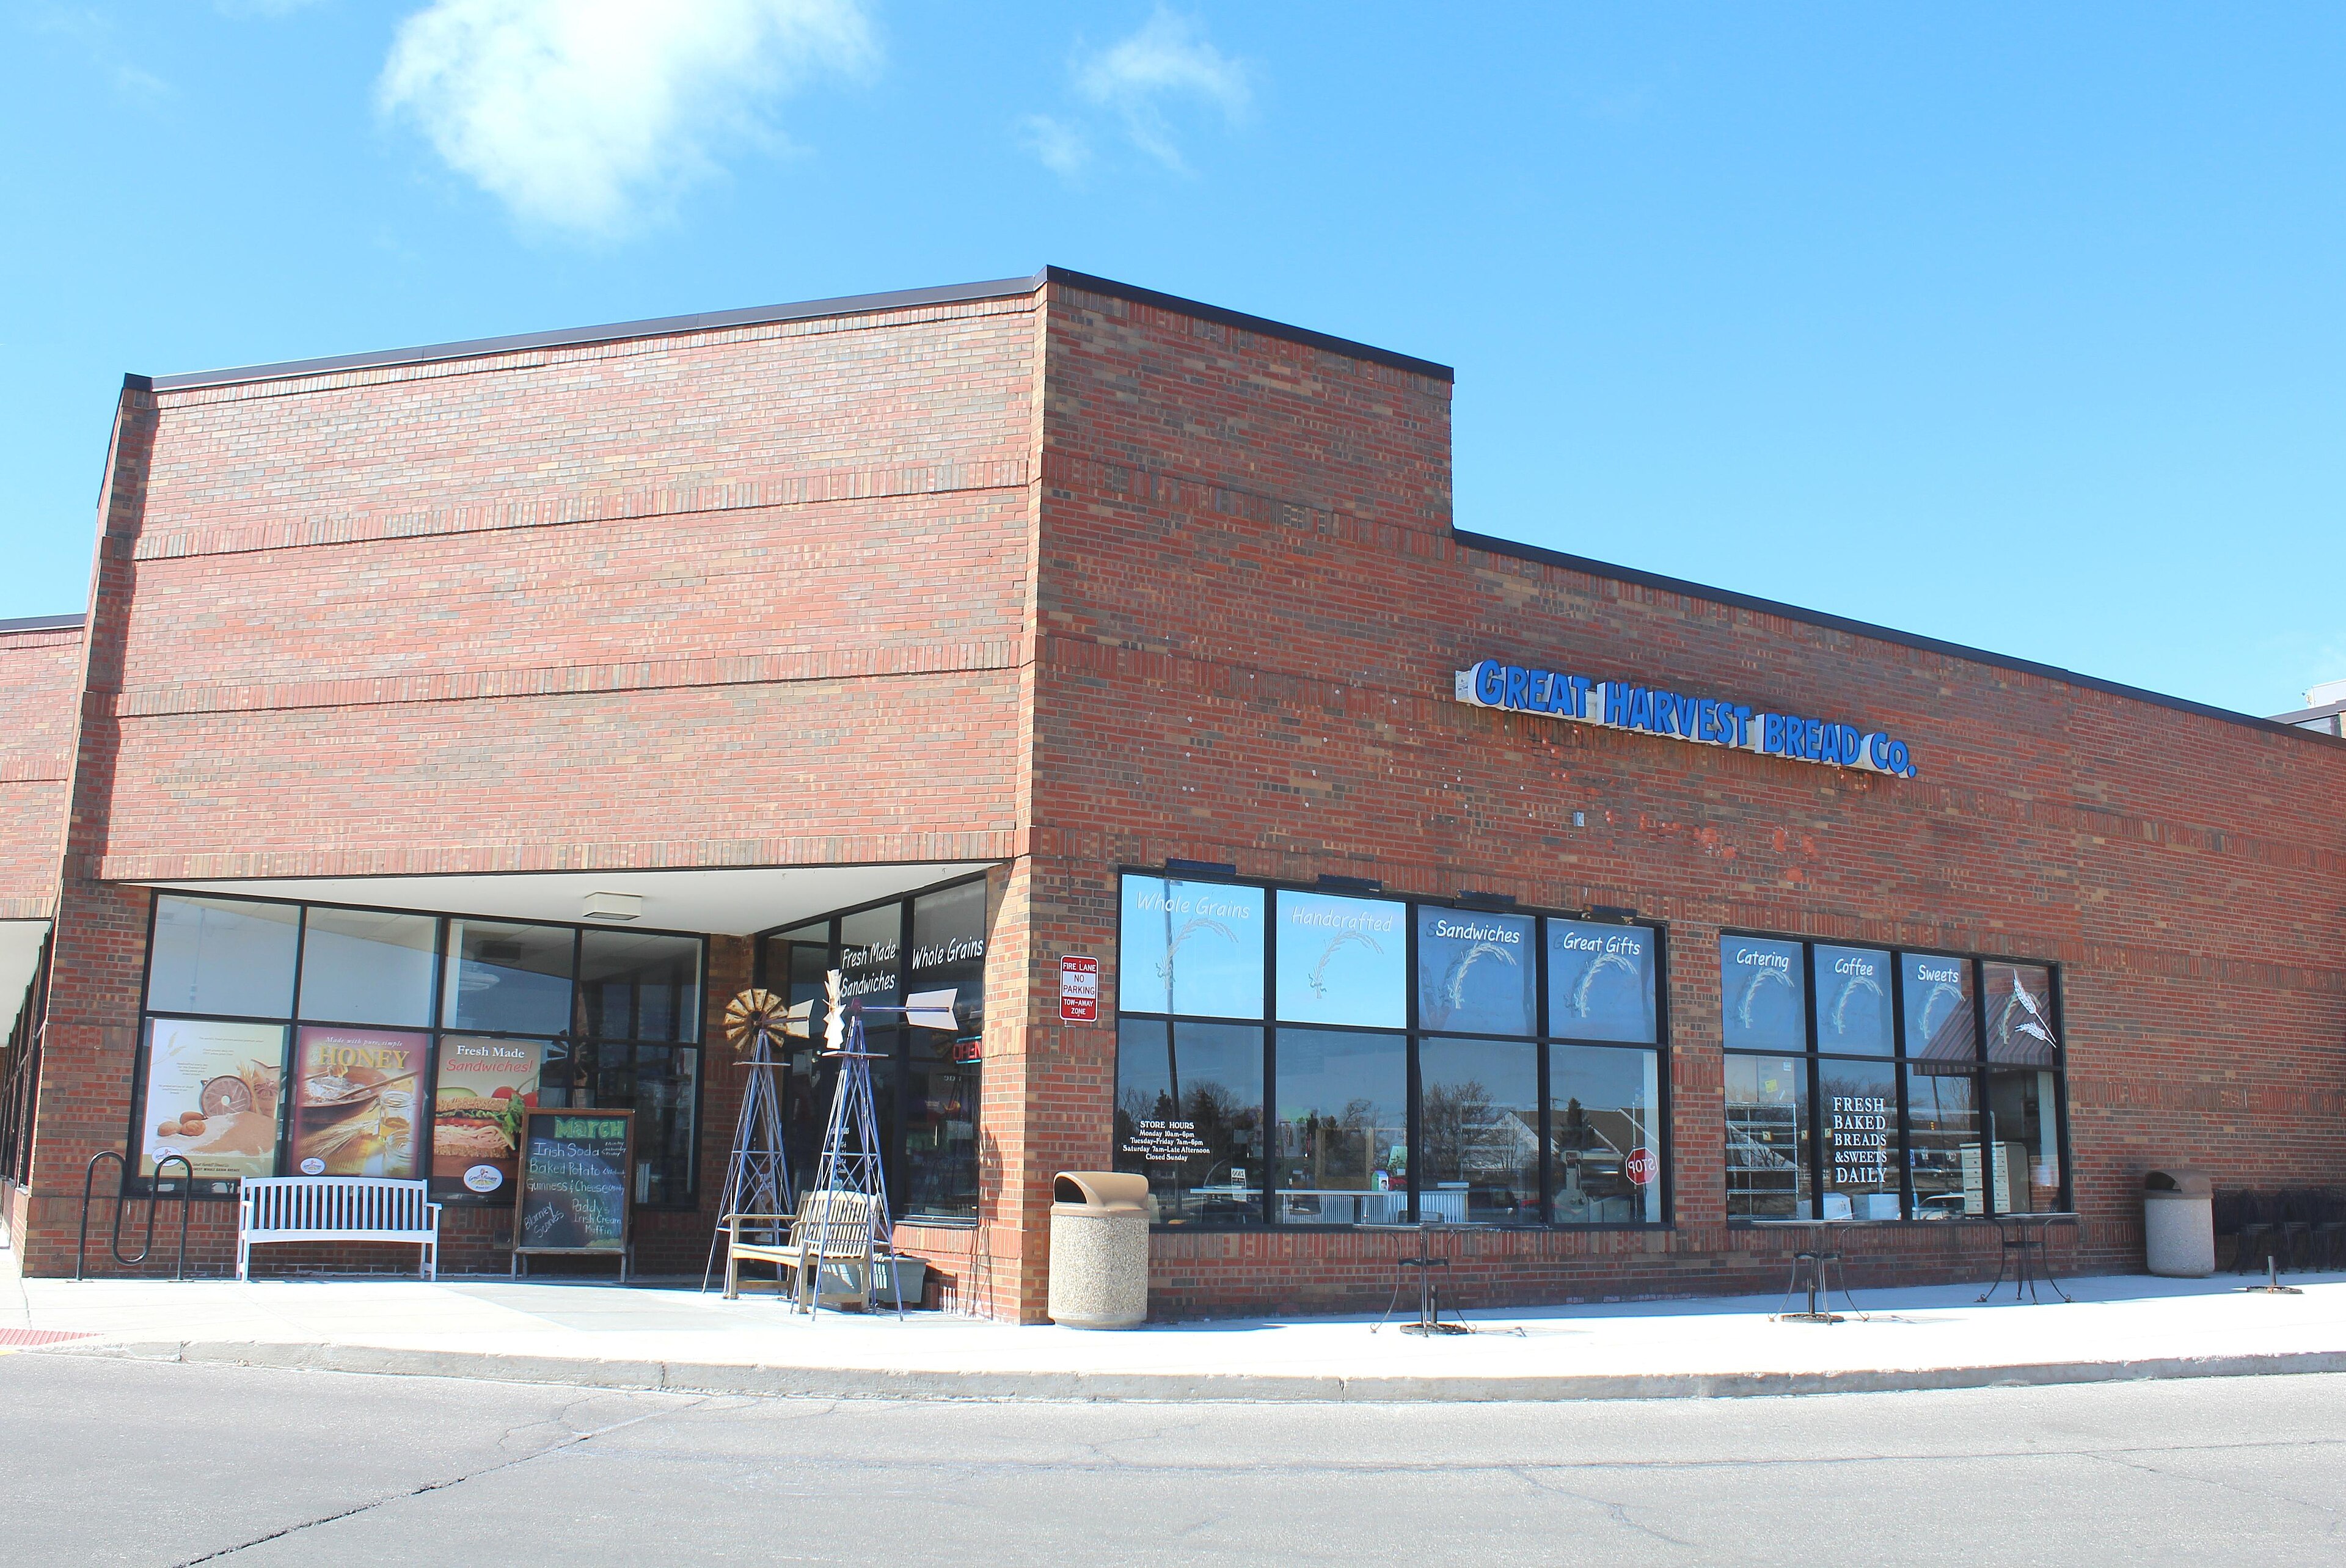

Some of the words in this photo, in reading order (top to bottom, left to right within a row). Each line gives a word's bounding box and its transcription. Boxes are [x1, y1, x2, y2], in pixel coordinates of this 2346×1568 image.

[1473, 658, 1591, 718] GREAT
[1602, 682, 1752, 745] HARVEST
[1760, 712, 1861, 766] BREAD
[1136, 891, 1190, 913] Whole
[1195, 896, 1251, 919] Grains
[1291, 905, 1392, 933] Handcrafted
[1436, 919, 1520, 944] Sandwiches
[1563, 932, 1602, 952] Great
[1606, 935, 1641, 956] Gifts
[842, 949, 867, 970] Fresh
[870, 938, 896, 963] Made
[912, 943, 945, 970] Whole
[946, 936, 984, 963] Grains
[1736, 948, 1789, 972] Catering
[1063, 961, 1077, 971] FIRE
[1079, 963, 1096, 972] LANE
[1835, 958, 1873, 977] Coffee
[1917, 964, 1959, 983] Sweets
[841, 970, 896, 997] Sandwiches
[1073, 974, 1085, 983] NO
[1063, 984, 1095, 995] PARKING
[1064, 999, 1094, 1007] TOW-AWAY
[1070, 1007, 1086, 1016] ZONE
[318, 1046, 410, 1070] HONEY
[456, 1045, 489, 1056] Fresh
[492, 1047, 525, 1058] Made
[954, 1041, 981, 1060] OPEN
[446, 1059, 533, 1073] Sandwiches!
[1833, 1097, 1885, 1112] FRESH
[1833, 1115, 1886, 1130] BAKED
[1130, 1137, 1174, 1145] Tuesday-Friday
[1834, 1134, 1887, 1146] BREADS
[533, 1142, 565, 1157] Irish
[568, 1143, 599, 1157] Soda
[1835, 1151, 1887, 1163] &SWEETS
[530, 1157, 565, 1174] Baked
[569, 1162, 601, 1176] Potato
[1836, 1167, 1887, 1183] DAILY
[526, 1178, 568, 1192] Guinness
[575, 1180, 608, 1193] Cheese
[524, 1202, 554, 1230] Blarney
[533, 1210, 565, 1238] Scones
[574, 1212, 594, 1223] Irish
[596, 1214, 621, 1224] Cream
[585, 1224, 612, 1235] Muffin
